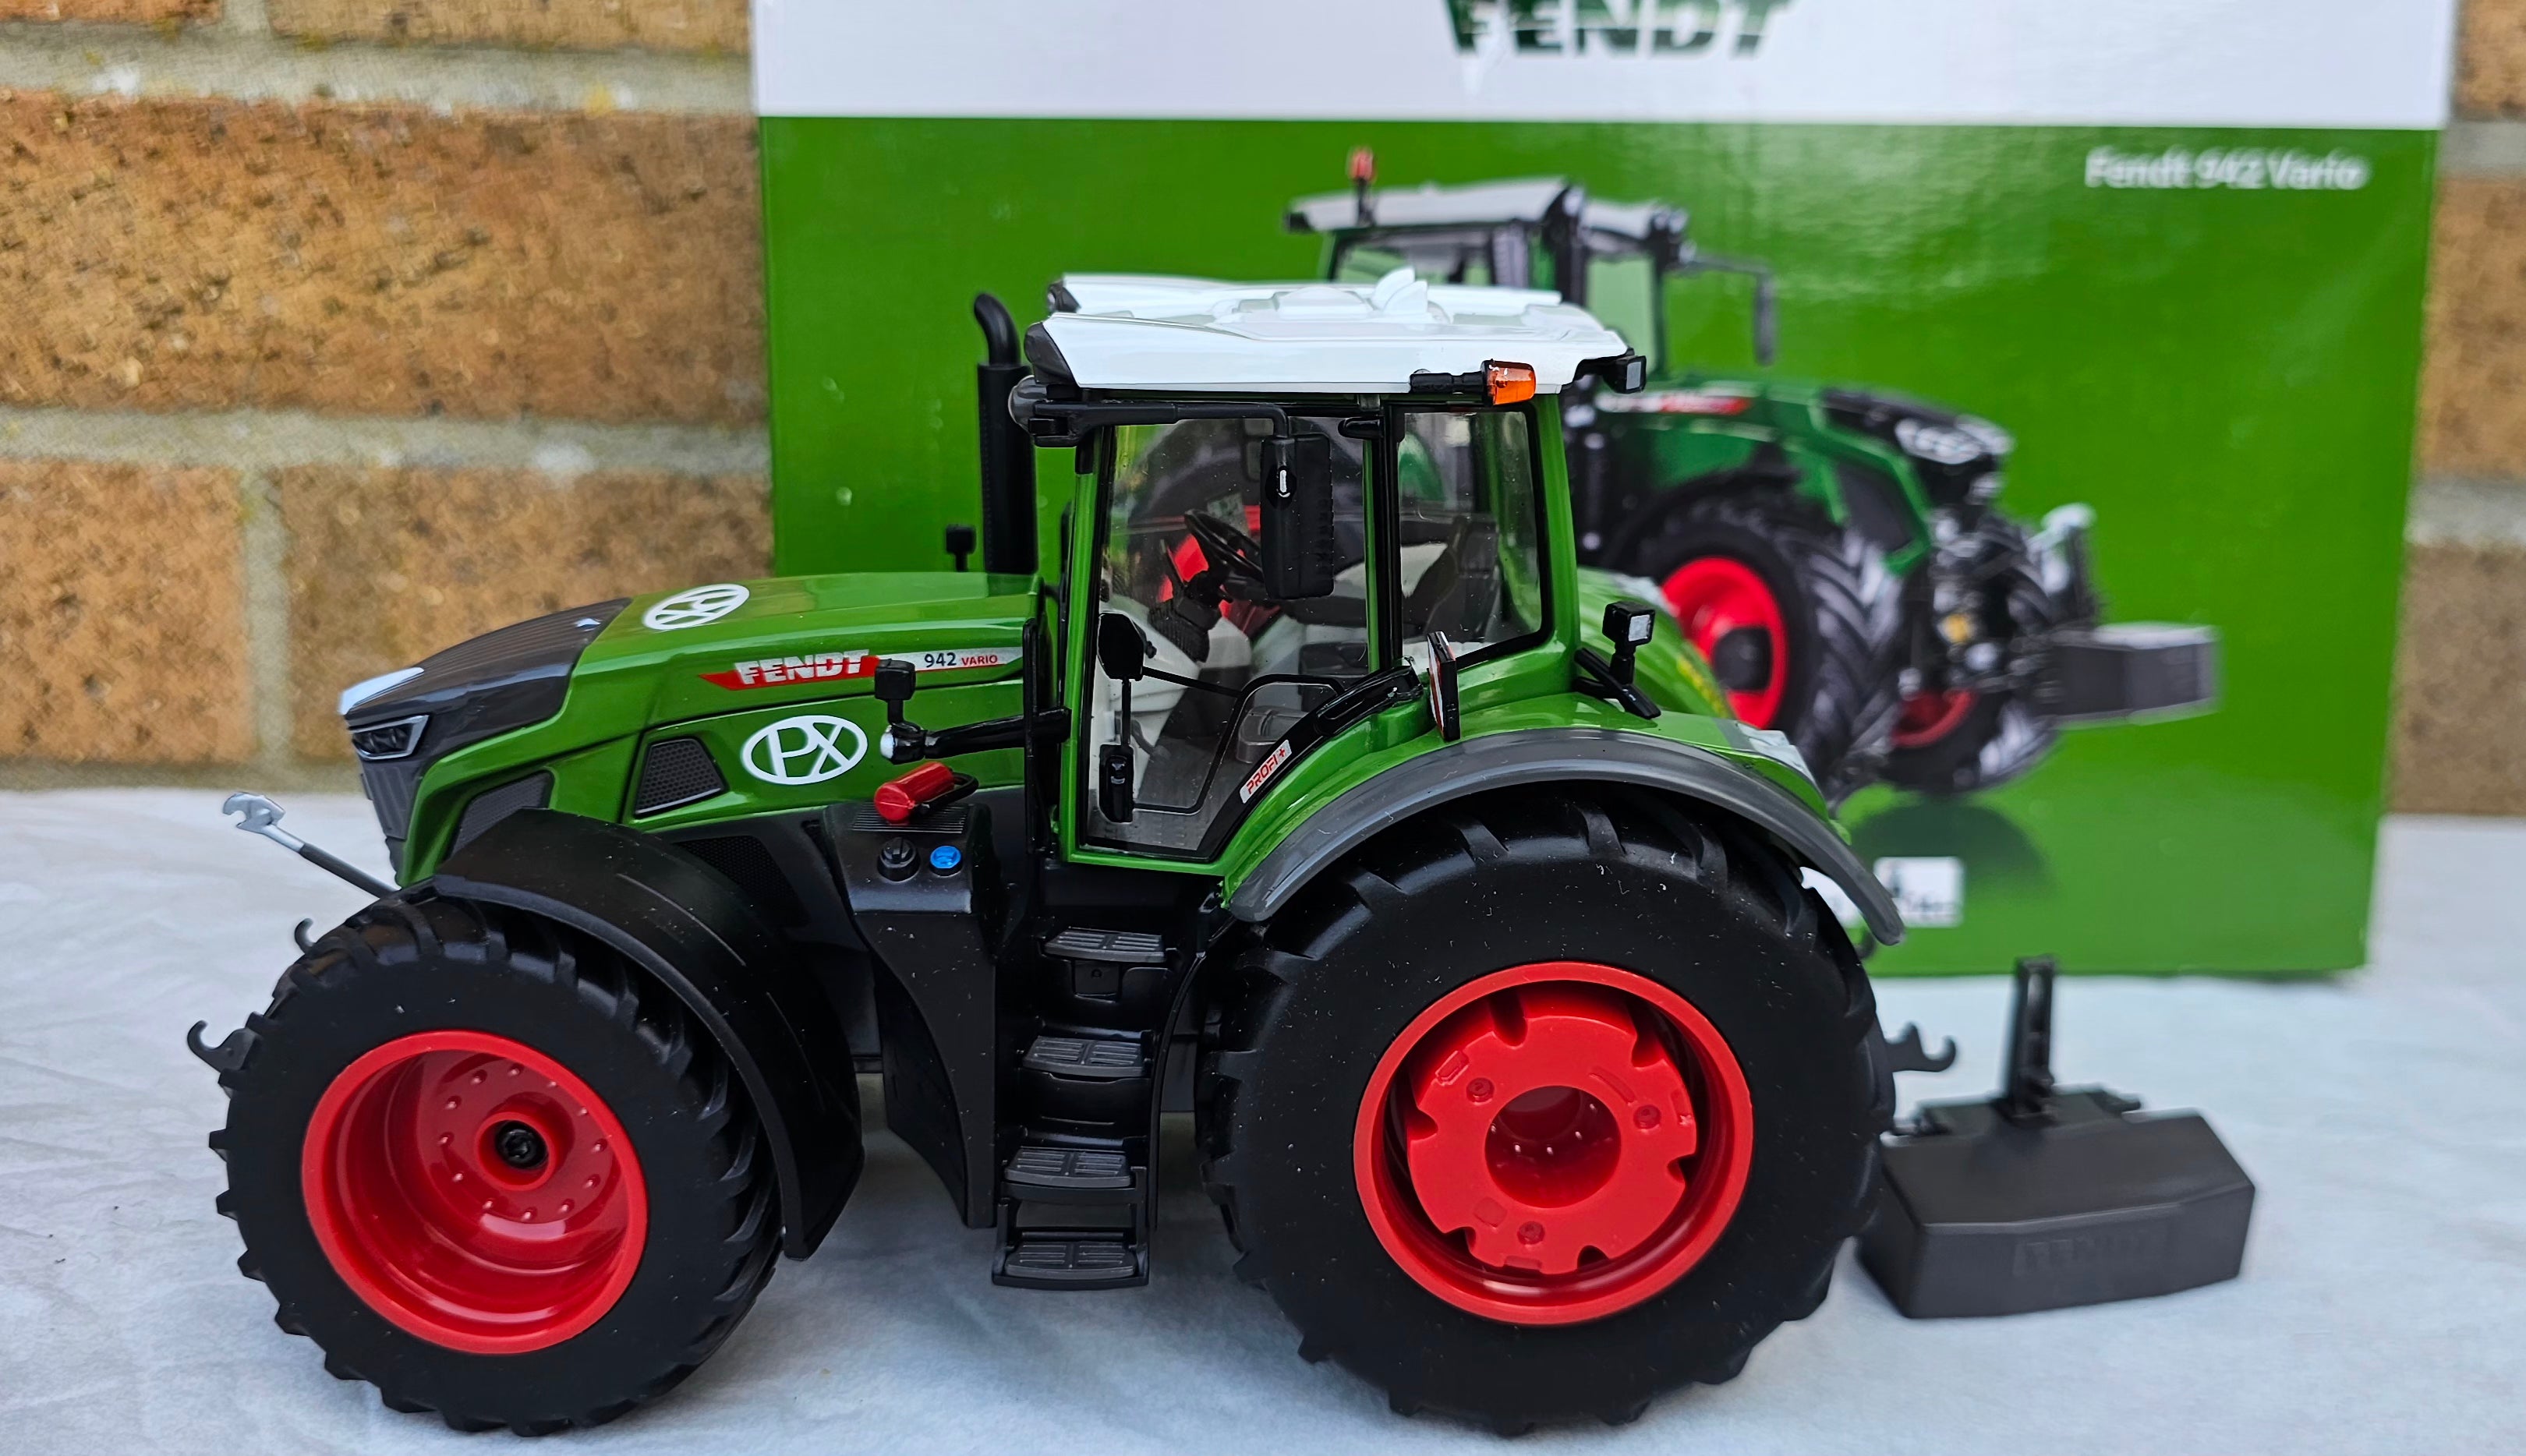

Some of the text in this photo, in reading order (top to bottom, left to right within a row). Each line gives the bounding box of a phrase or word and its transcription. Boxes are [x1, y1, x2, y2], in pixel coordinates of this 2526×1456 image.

[1439, 0, 1795, 58] FENDT
[2086, 146, 2371, 189] Fendt 942 Vario
[735, 649, 869, 685] FENDT
[924, 652, 998, 668] 942 VARIO
